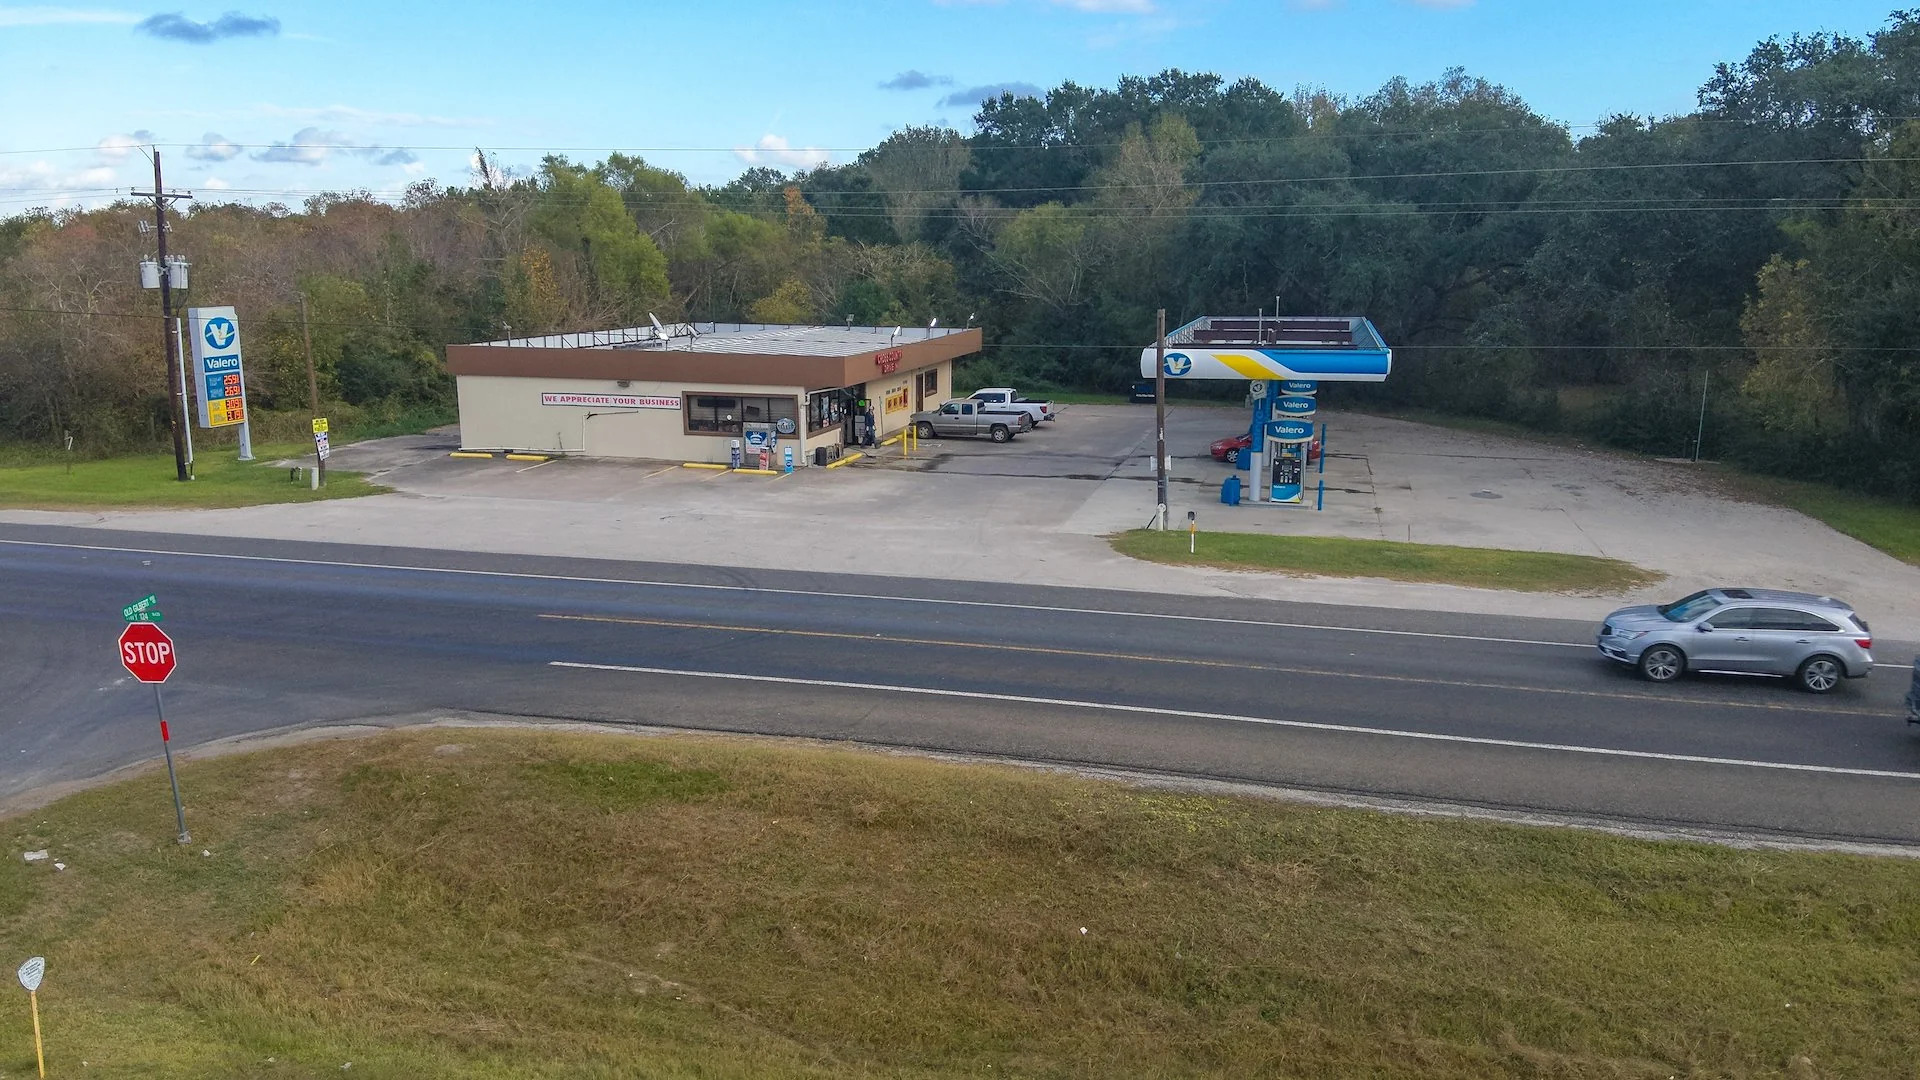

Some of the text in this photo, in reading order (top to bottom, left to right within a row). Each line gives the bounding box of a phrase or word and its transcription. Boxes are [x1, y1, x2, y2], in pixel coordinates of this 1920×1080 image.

[206, 358, 238, 369] Valero
[560, 396, 610, 404] APPRECIATE
[639, 399, 680, 407] BUSINESS
[1283, 401, 1309, 409] Valero
[1275, 426, 1305, 434] Valero
[124, 607, 133, 616] OLD
[124, 641, 170, 664] STOP
